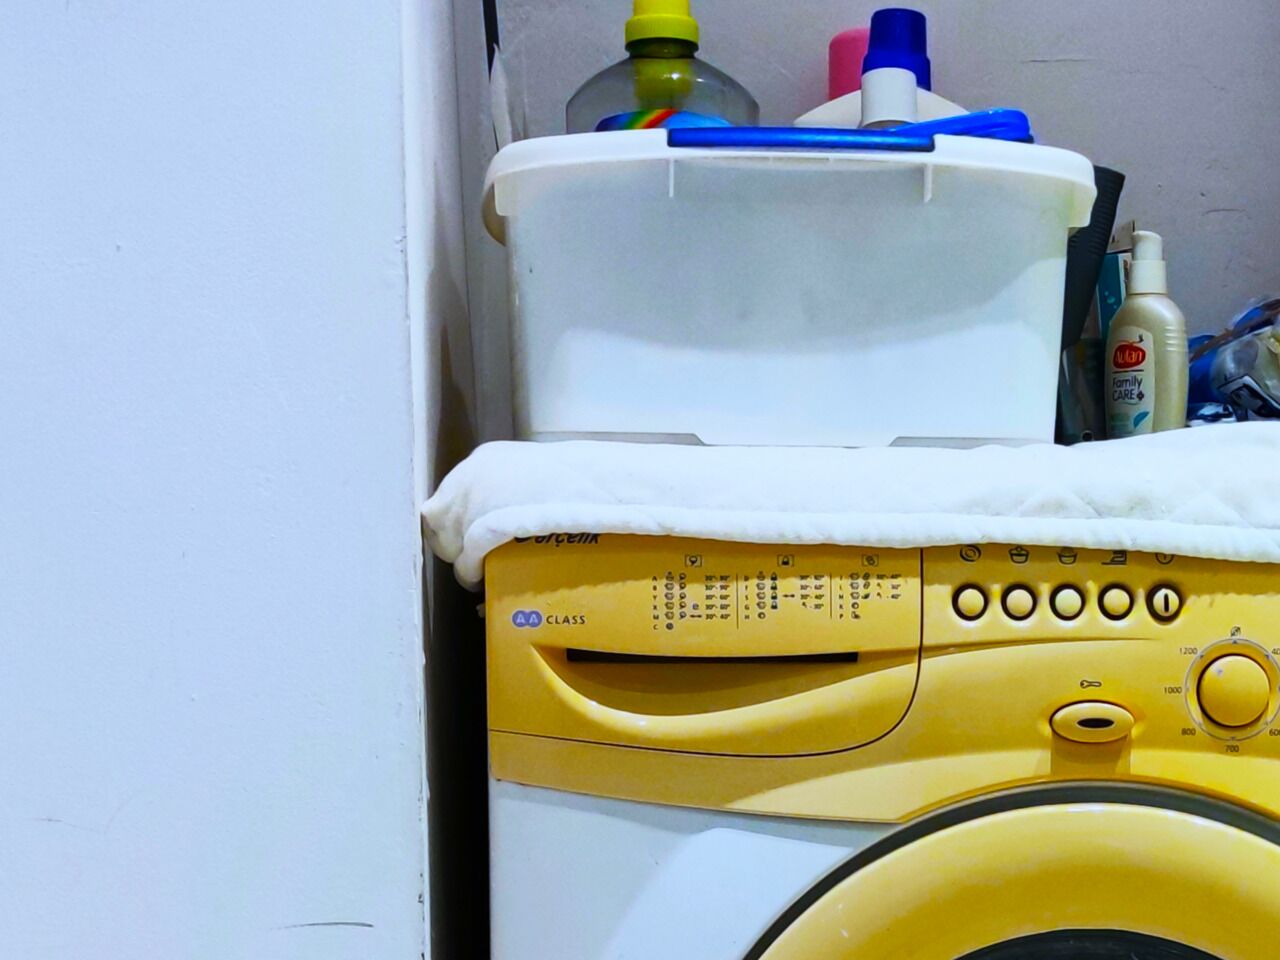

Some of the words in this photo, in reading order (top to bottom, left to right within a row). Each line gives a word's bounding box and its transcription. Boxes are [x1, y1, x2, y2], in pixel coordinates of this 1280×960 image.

[1112, 375, 1143, 389] Family
[1112, 389, 1136, 401] CARE
[546, 615, 586, 625] CLASS
[1179, 647, 1198, 655] 1200
[1181, 728, 1196, 736] 800
[1225, 745, 1240, 753] 700
